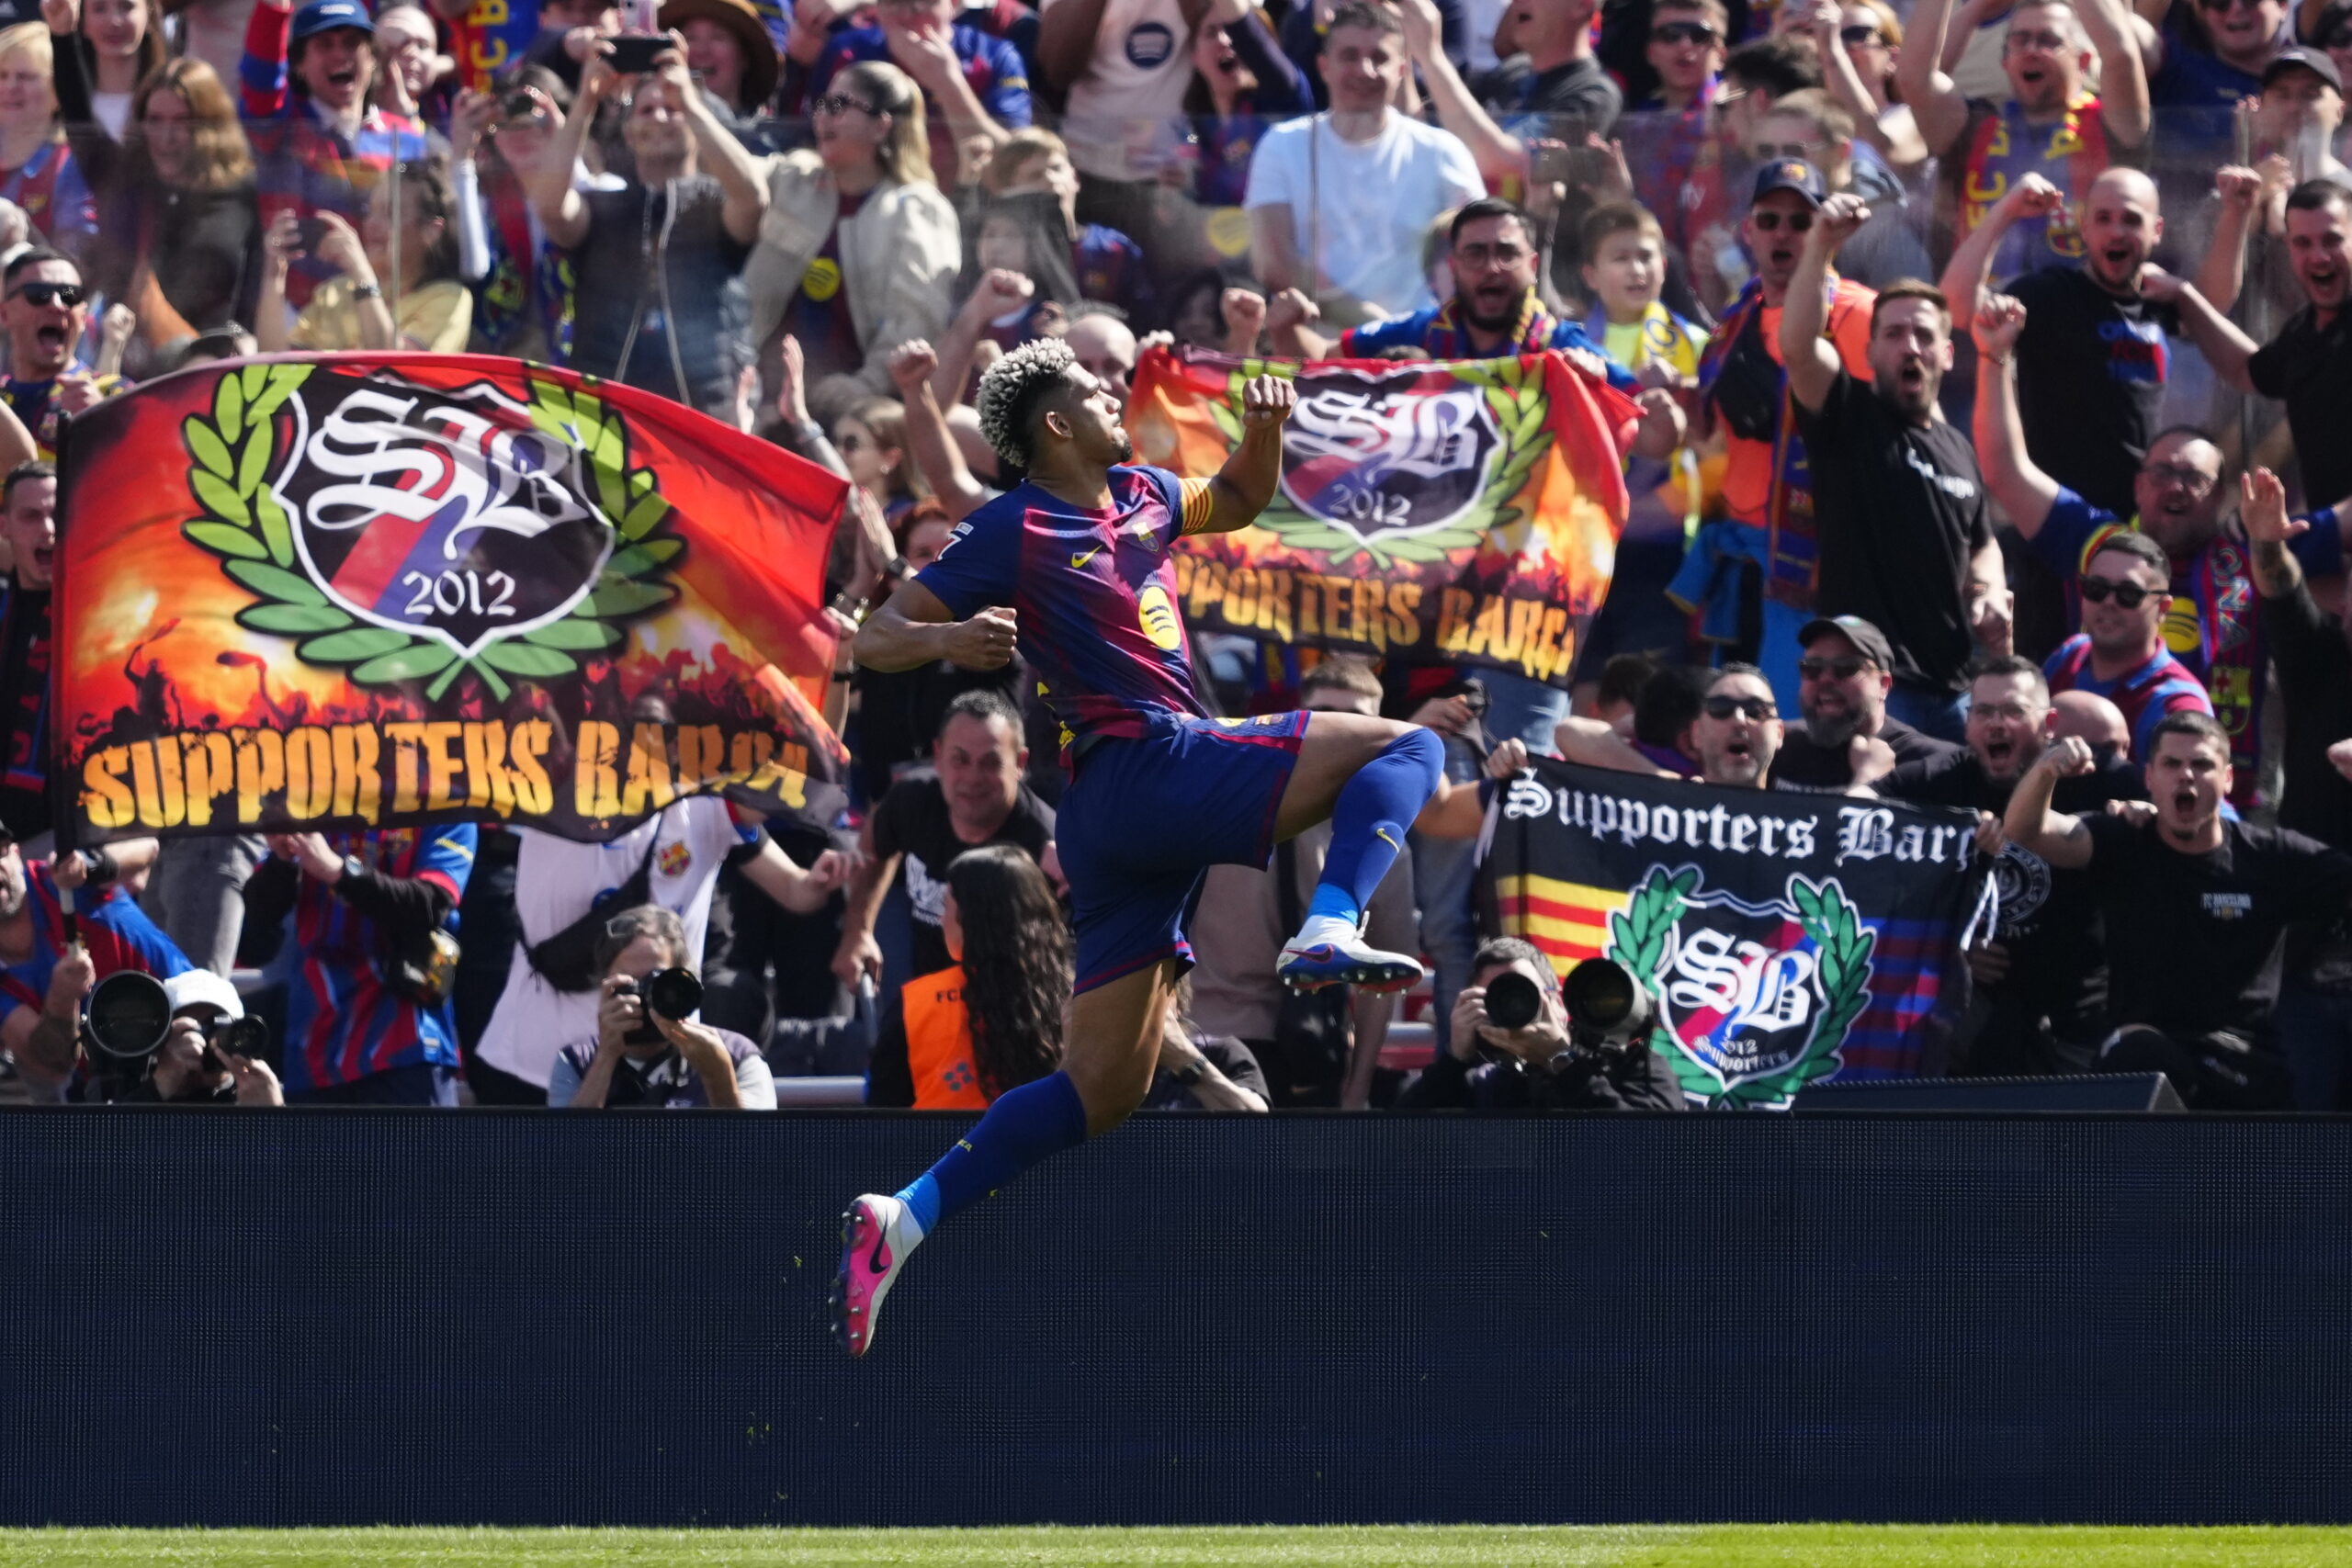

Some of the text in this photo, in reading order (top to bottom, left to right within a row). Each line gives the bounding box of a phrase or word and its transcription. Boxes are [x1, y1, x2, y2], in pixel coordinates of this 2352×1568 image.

[1329, 483, 1412, 526] 2012
[401, 569, 517, 616] 2012
[1175, 553, 1424, 652] PORTERS
[76, 716, 555, 829] SUPPORTERS
[1503, 766, 1977, 871] Supporters Barç
[935, 990, 963, 1003] FC
